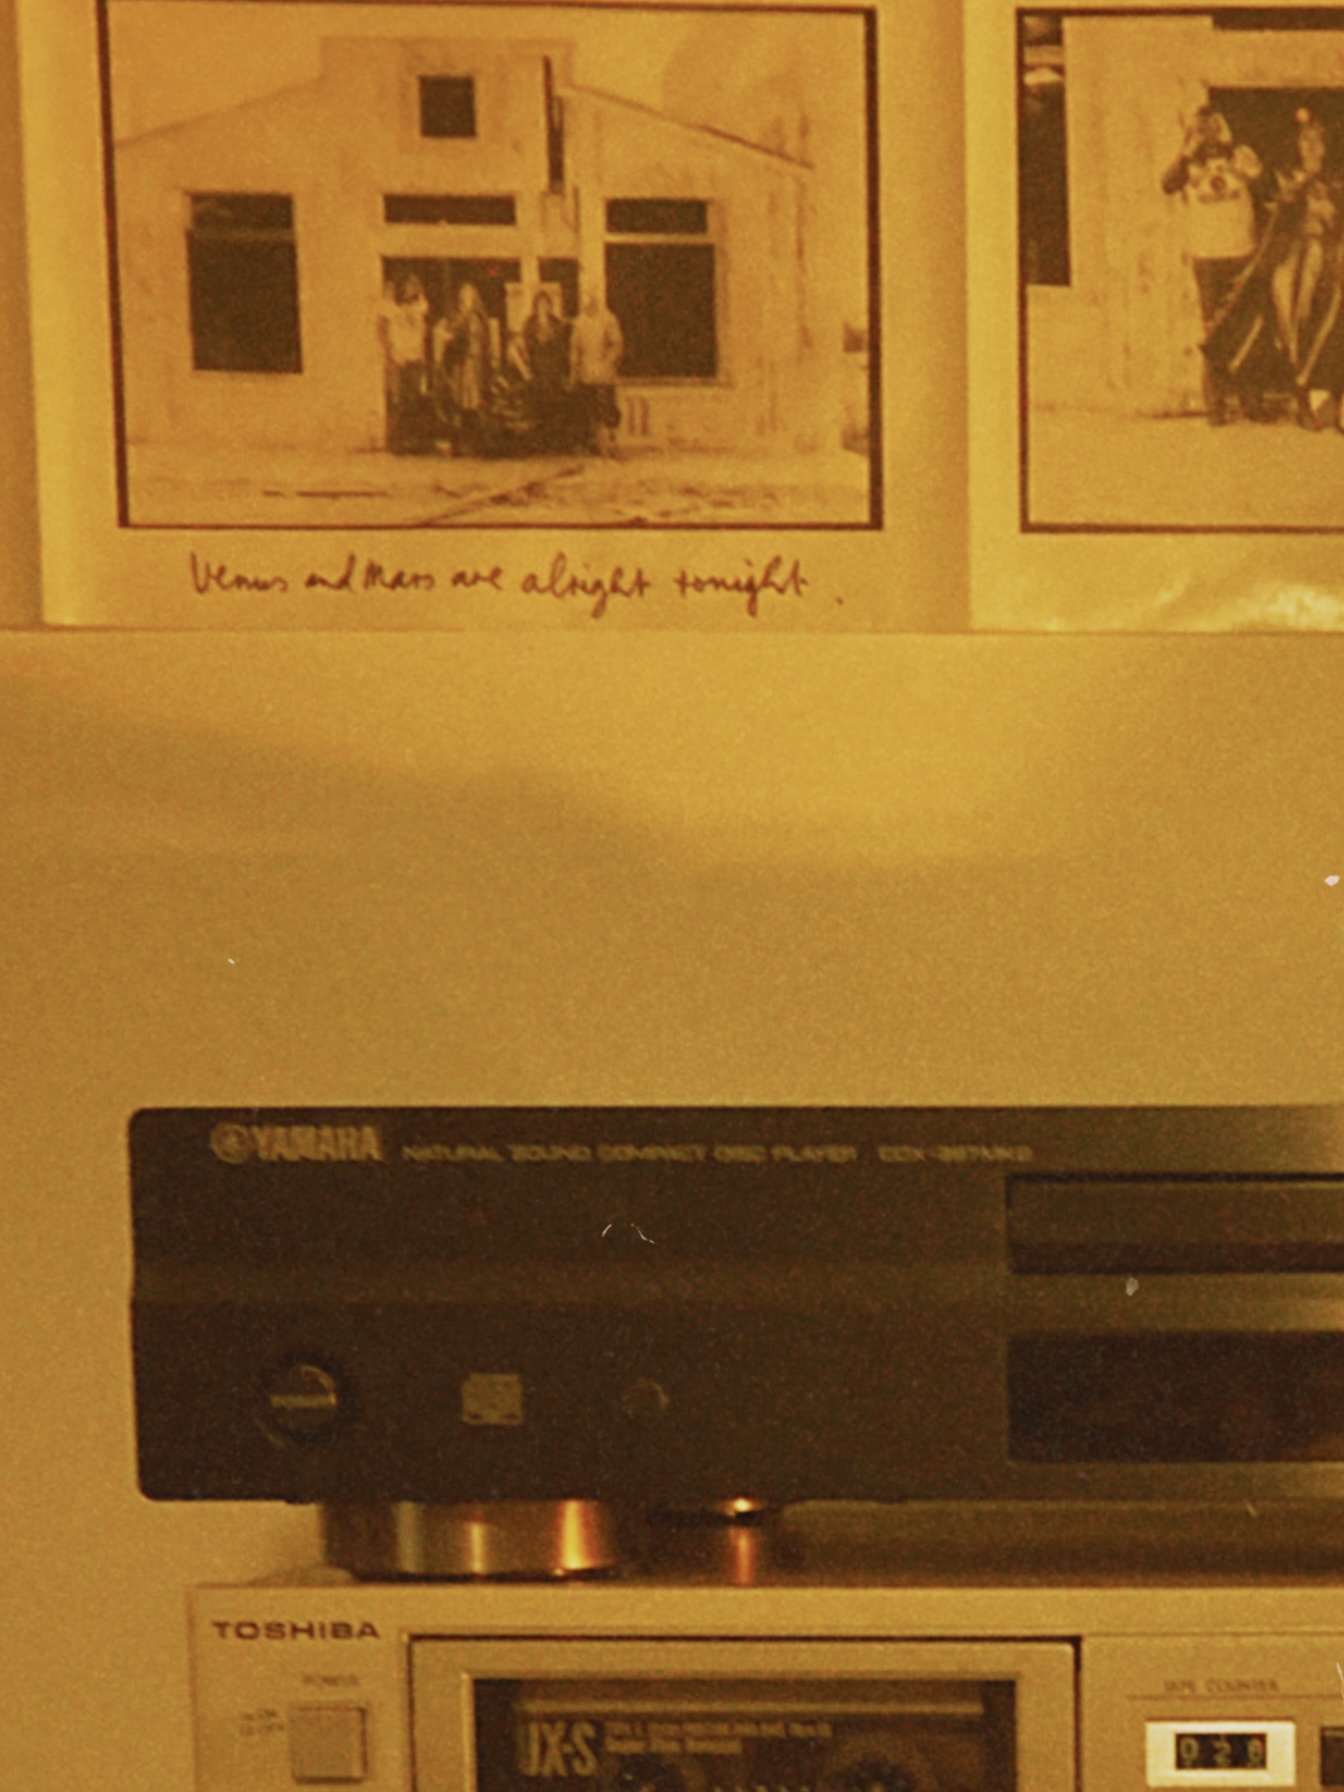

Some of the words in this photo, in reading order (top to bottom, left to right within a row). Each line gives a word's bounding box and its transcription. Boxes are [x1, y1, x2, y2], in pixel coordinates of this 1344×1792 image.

[190, 552, 288, 594] Venus
[304, 552, 356, 594] and
[362, 559, 436, 591] Mars
[451, 565, 504, 591] are
[520, 551, 651, 620] alright
[251, 1124, 383, 1161] YAMAHA
[211, 1620, 382, 1641] TOSHIBA
